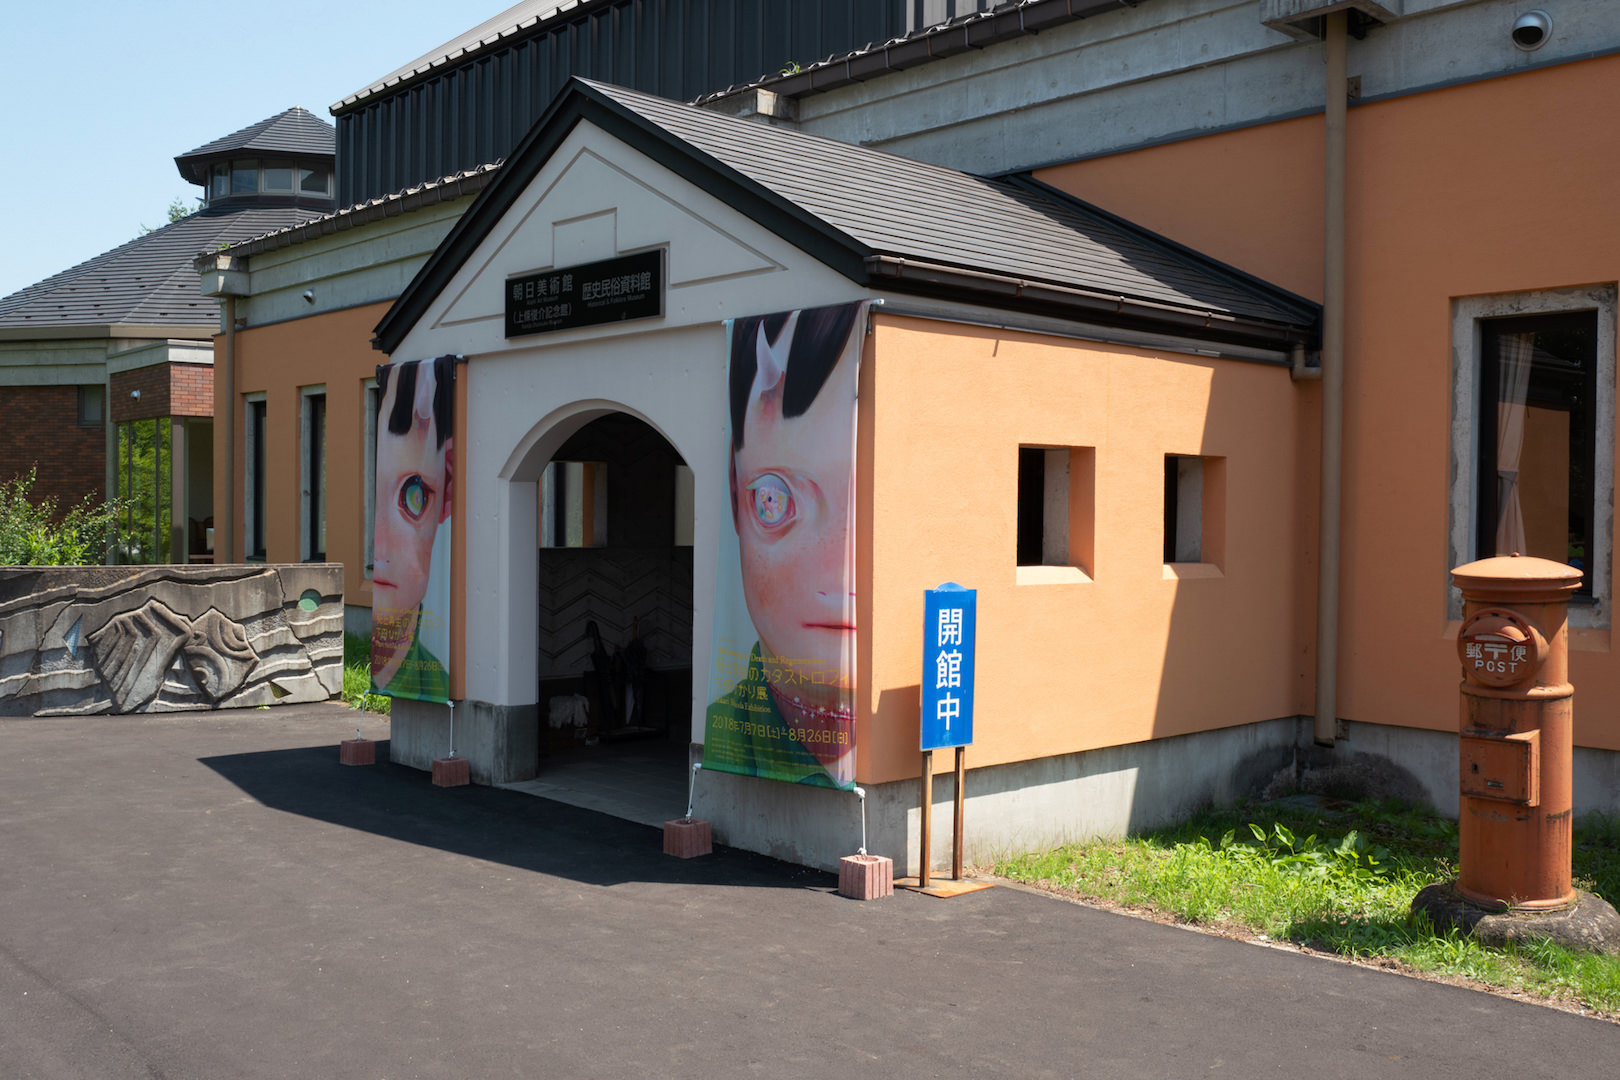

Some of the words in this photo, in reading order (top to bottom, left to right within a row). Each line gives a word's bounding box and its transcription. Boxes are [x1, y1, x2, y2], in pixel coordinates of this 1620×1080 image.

[512, 274, 573, 301] 朝日美術館
[935, 608, 963, 731] 開館中
[1475, 660, 1518, 673] POST
